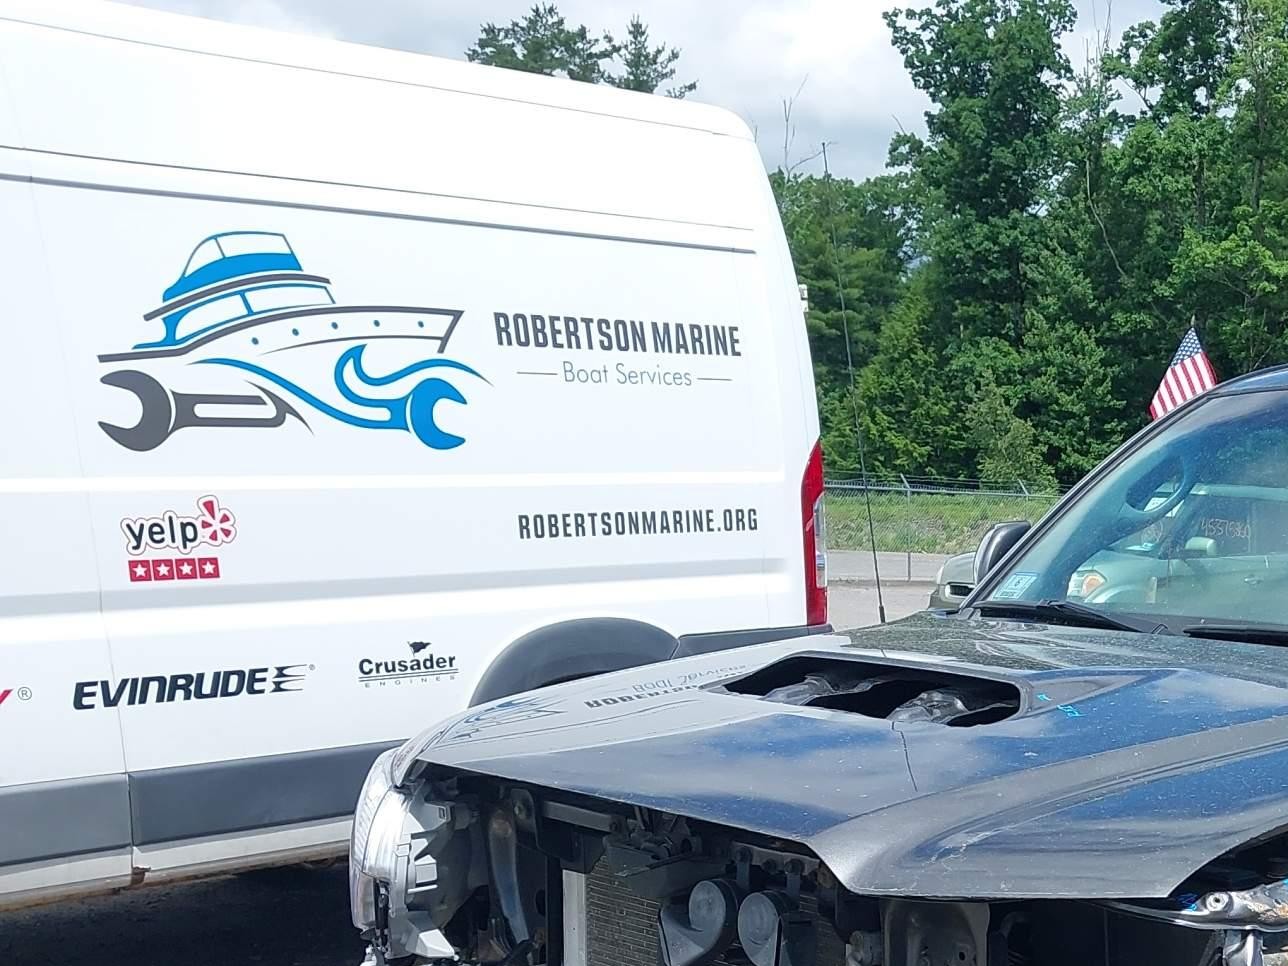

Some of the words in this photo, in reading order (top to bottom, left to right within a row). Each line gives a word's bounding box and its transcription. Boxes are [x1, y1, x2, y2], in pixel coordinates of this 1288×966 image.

[493, 311, 648, 353] ROBERTSON
[650, 321, 742, 357] MARINE
[562, 360, 609, 384] Boat
[615, 362, 693, 387] Services
[125, 515, 198, 551] yelp
[517, 508, 759, 540] ROBERTSONMARINE.ORG
[358, 652, 457, 676] Crusader
[73, 667, 270, 711] EVINRUDE
